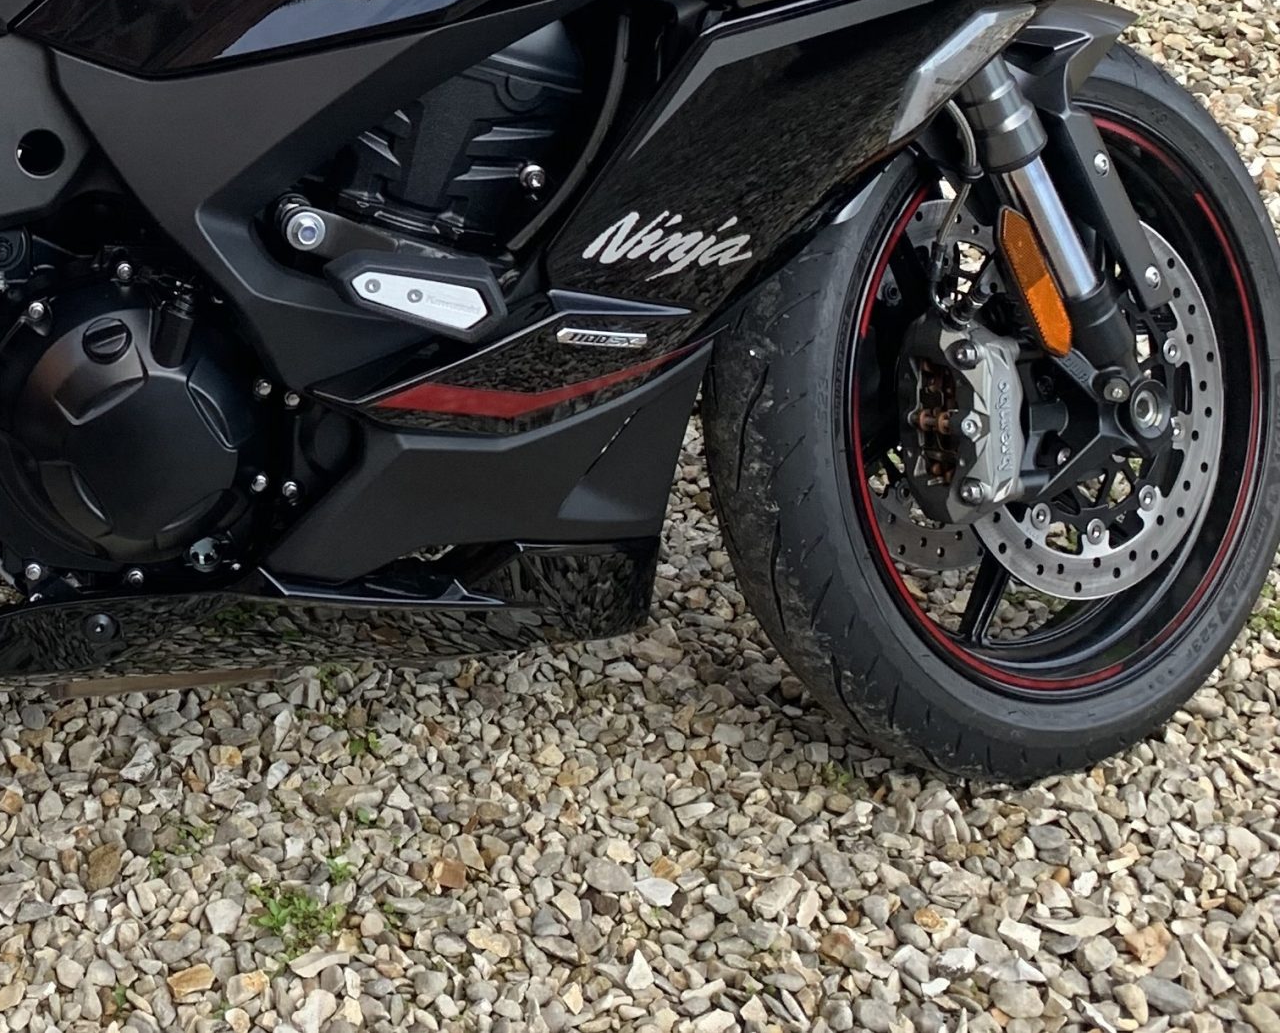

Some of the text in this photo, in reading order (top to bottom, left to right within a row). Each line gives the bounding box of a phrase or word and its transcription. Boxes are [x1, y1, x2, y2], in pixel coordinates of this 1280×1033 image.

[582, 210, 753, 282] Ninja
[569, 331, 642, 346] 1100SX
[995, 380, 1012, 472] brembo
